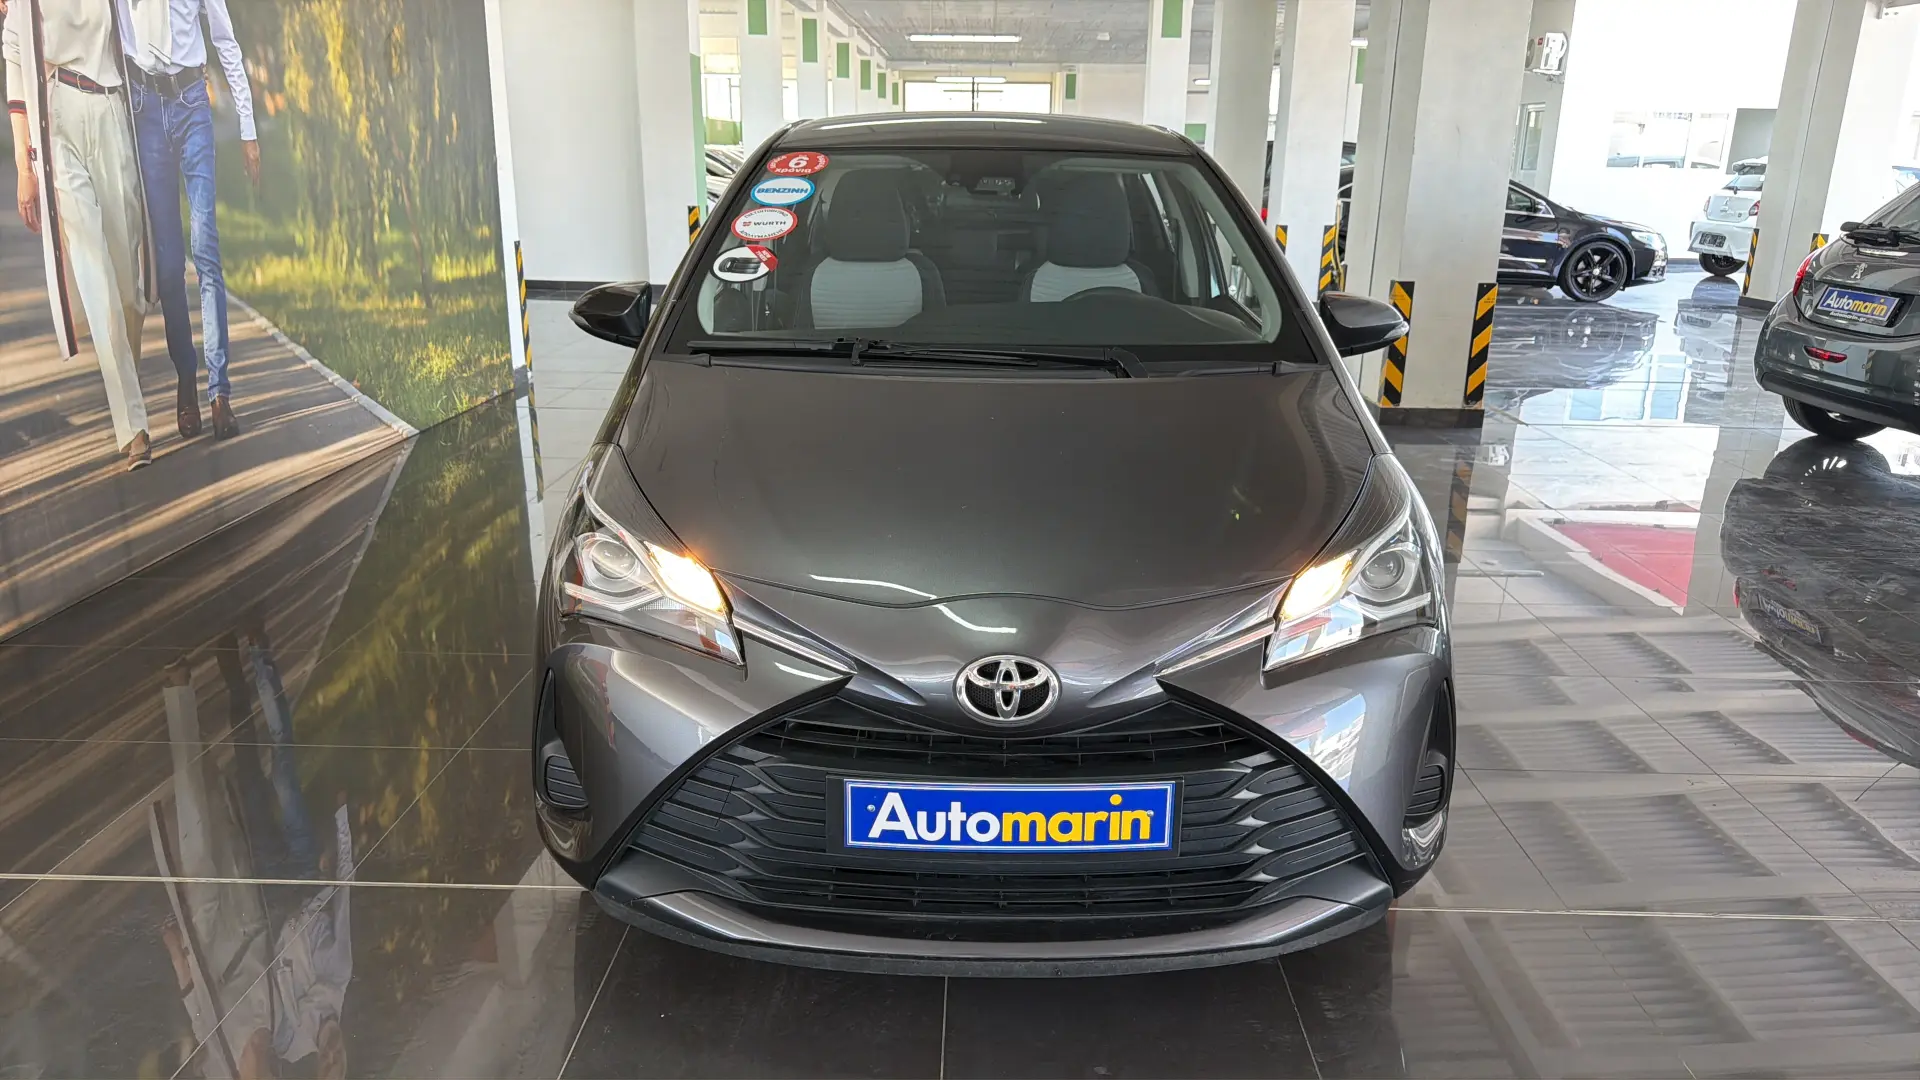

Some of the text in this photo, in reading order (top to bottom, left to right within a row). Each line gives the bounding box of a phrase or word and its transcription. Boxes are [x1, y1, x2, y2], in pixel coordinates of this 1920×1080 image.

[788, 155, 810, 169] 6
[1823, 290, 1888, 317] Automarin
[868, 792, 1151, 842] Automarin
